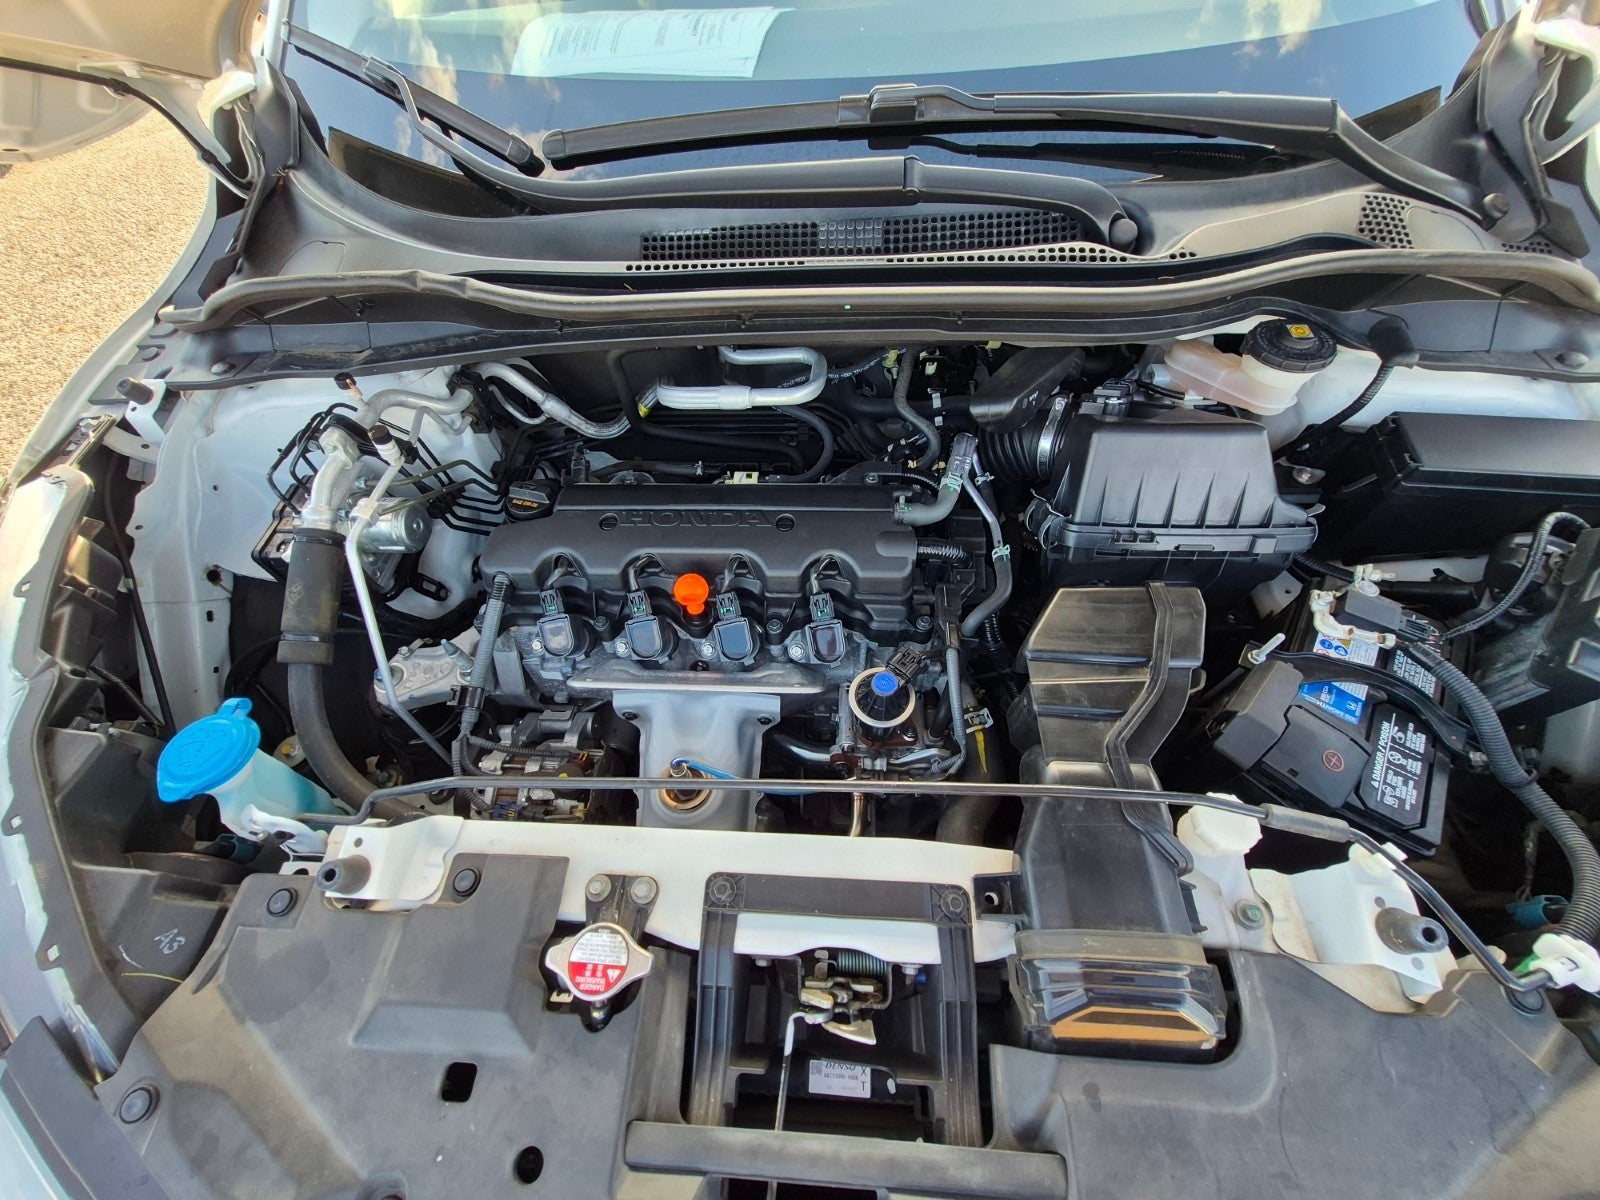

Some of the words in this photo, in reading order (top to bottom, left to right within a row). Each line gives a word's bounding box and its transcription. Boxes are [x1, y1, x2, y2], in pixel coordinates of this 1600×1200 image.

[620, 511, 772, 527] HONDA
[1316, 700, 1345, 717] MONTH
[1379, 721, 1391, 748] POISON
[1373, 751, 1386, 781] DANGER
[575, 976, 606, 984] WARNING
[579, 983, 605, 992] DANGER
[825, 1062, 856, 1071] DENSO
